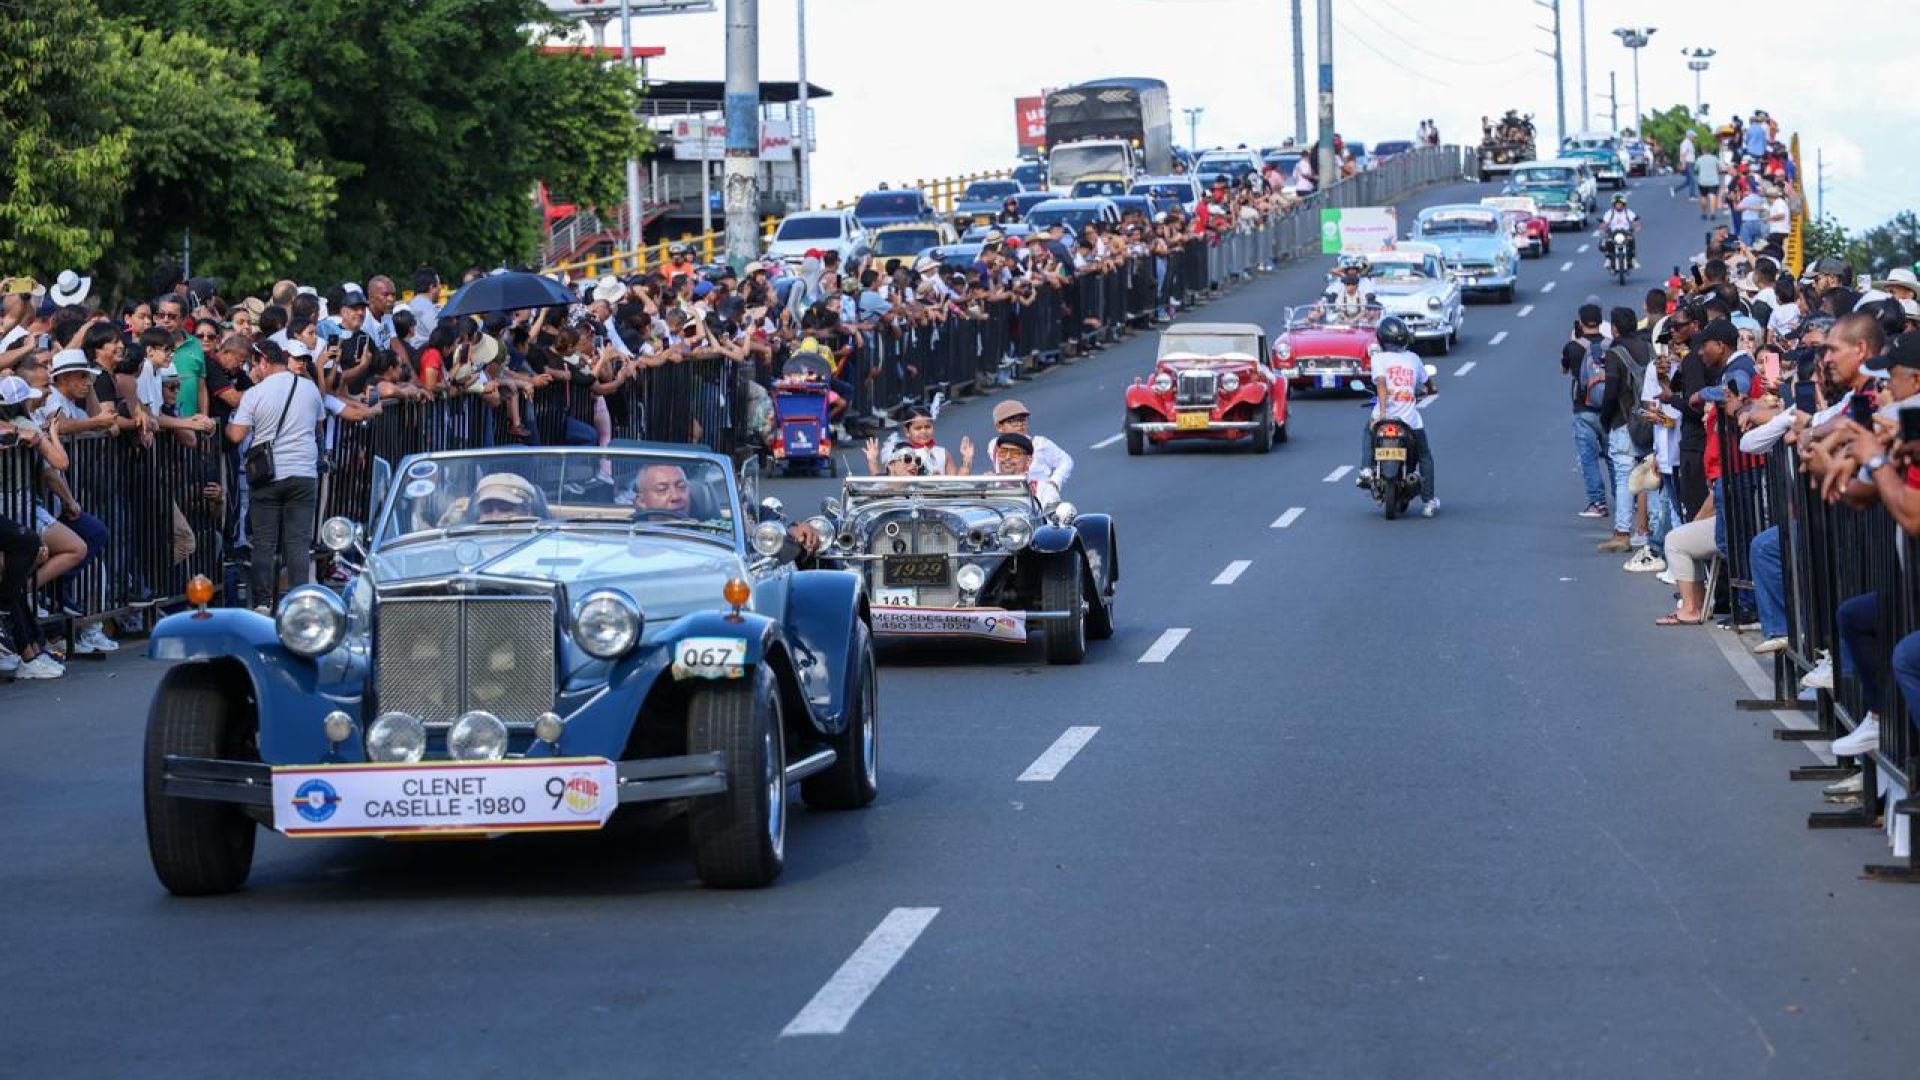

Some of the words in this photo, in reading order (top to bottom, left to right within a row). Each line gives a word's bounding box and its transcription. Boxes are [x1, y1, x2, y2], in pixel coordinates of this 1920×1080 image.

[684, 648, 732, 667] 067
[402, 776, 487, 796] CLENET
[364, 797, 462, 818] CASELLE
